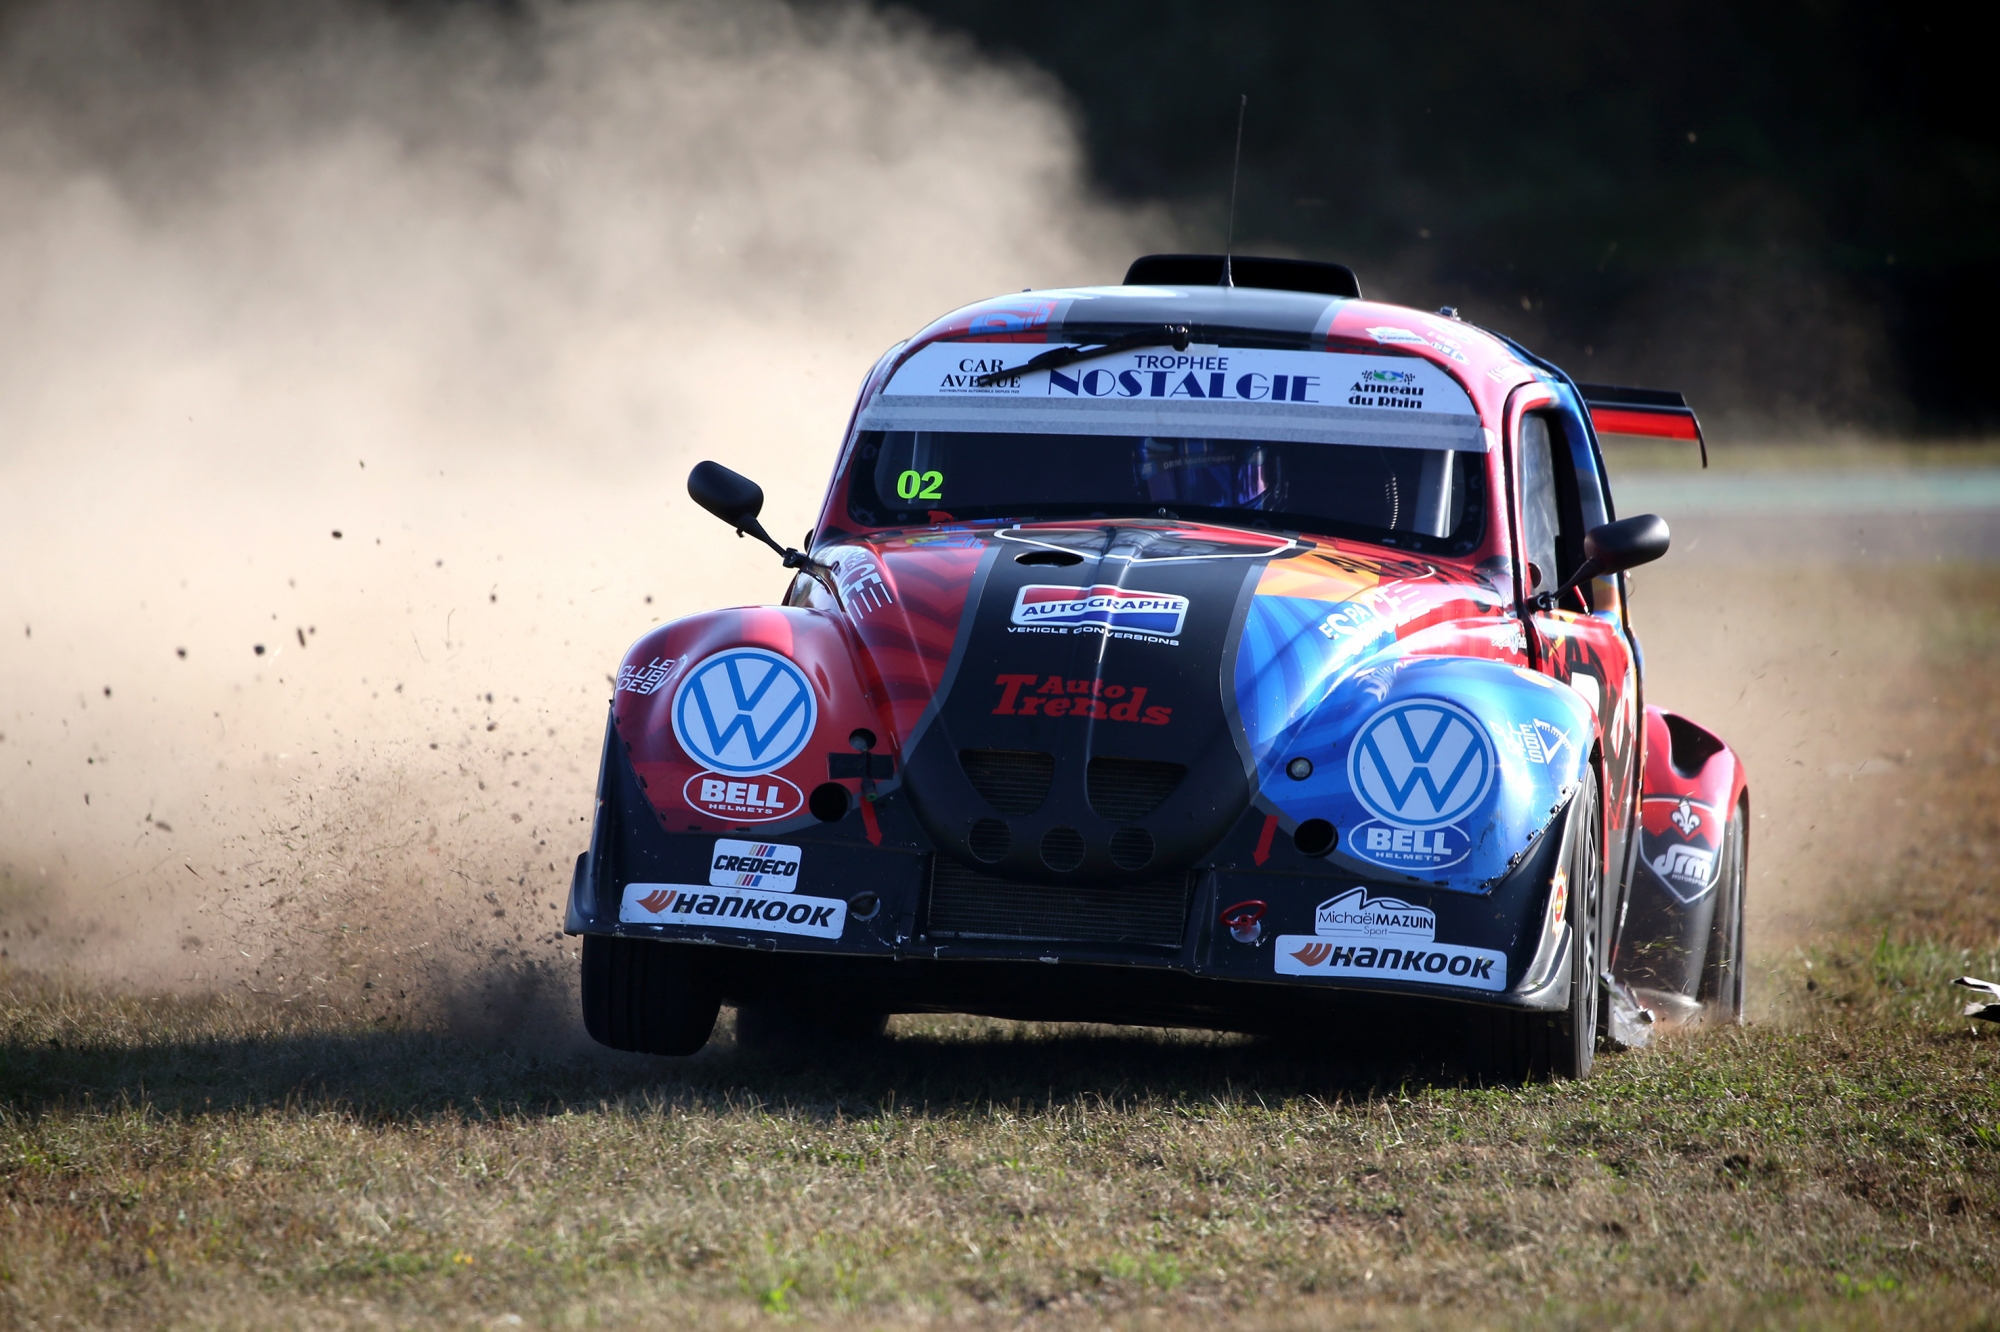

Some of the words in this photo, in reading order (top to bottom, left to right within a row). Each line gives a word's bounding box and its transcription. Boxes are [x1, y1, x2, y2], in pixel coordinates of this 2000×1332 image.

[959, 358, 1004, 373] CAR
[1134, 355, 1229, 370] TROPHEE
[1048, 369, 1320, 403] NOSTALGIE
[1350, 381, 1424, 396] Anneau
[1348, 395, 1373, 406] du
[1378, 396, 1422, 409] Rhin
[1163, 458, 1182, 470] DRM
[1184, 454, 1236, 465] Motorsport
[897, 470, 943, 499] 02
[1022, 598, 1184, 616] AUTOGRAPHE
[1073, 626, 1180, 646] CONVERSIONS
[648, 656, 675, 671] LE
[619, 665, 665, 683] CLUB
[617, 678, 654, 695] DES
[1036, 676, 1126, 699] Auto
[992, 673, 1172, 726] Trends
[700, 778, 784, 808] BELL
[709, 803, 773, 814] HELMETS
[1366, 827, 1452, 855] BELL
[713, 855, 798, 876] CREDECO
[1375, 852, 1441, 862] HELMETS
[671, 893, 836, 928] HANKOOK
[1364, 926, 1387, 936] Sport
[1330, 946, 1495, 980] HANKOOK
